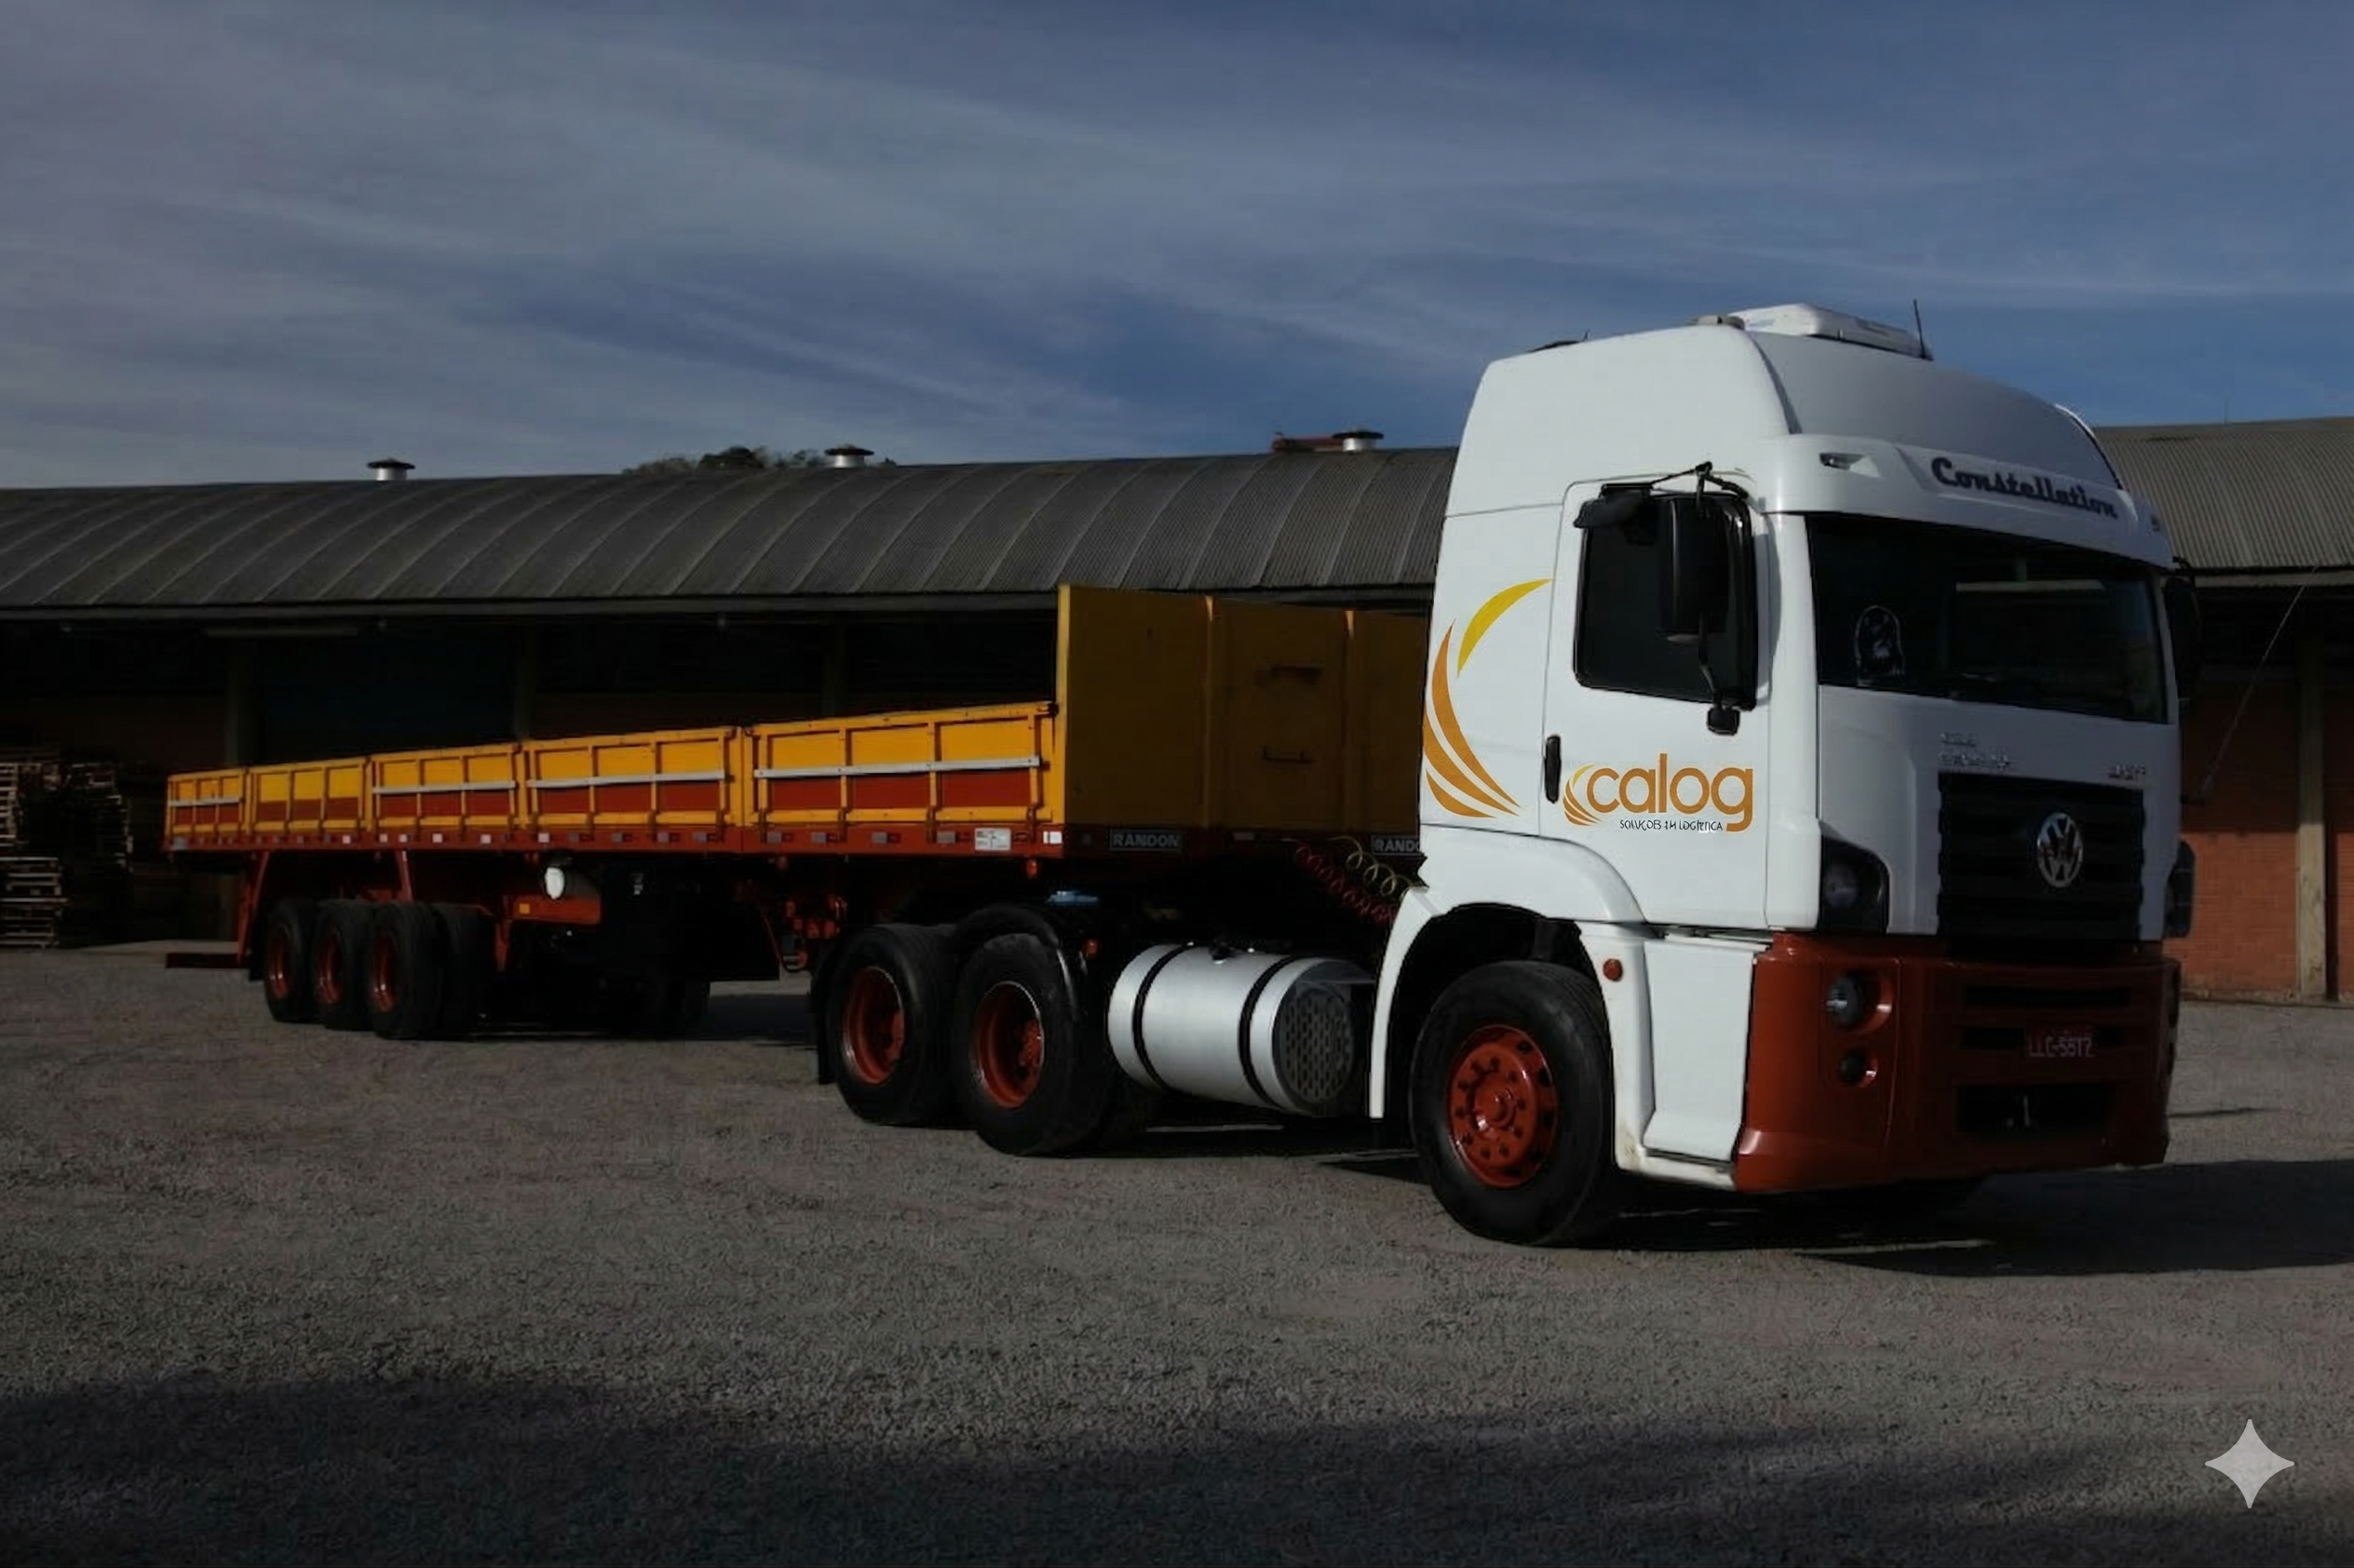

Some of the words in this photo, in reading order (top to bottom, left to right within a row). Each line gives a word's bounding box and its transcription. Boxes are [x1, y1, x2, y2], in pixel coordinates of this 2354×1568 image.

[1931, 457, 2118, 519] Constellation
[1586, 752, 1754, 832] calog
[1113, 833, 1180, 847] RANDON
